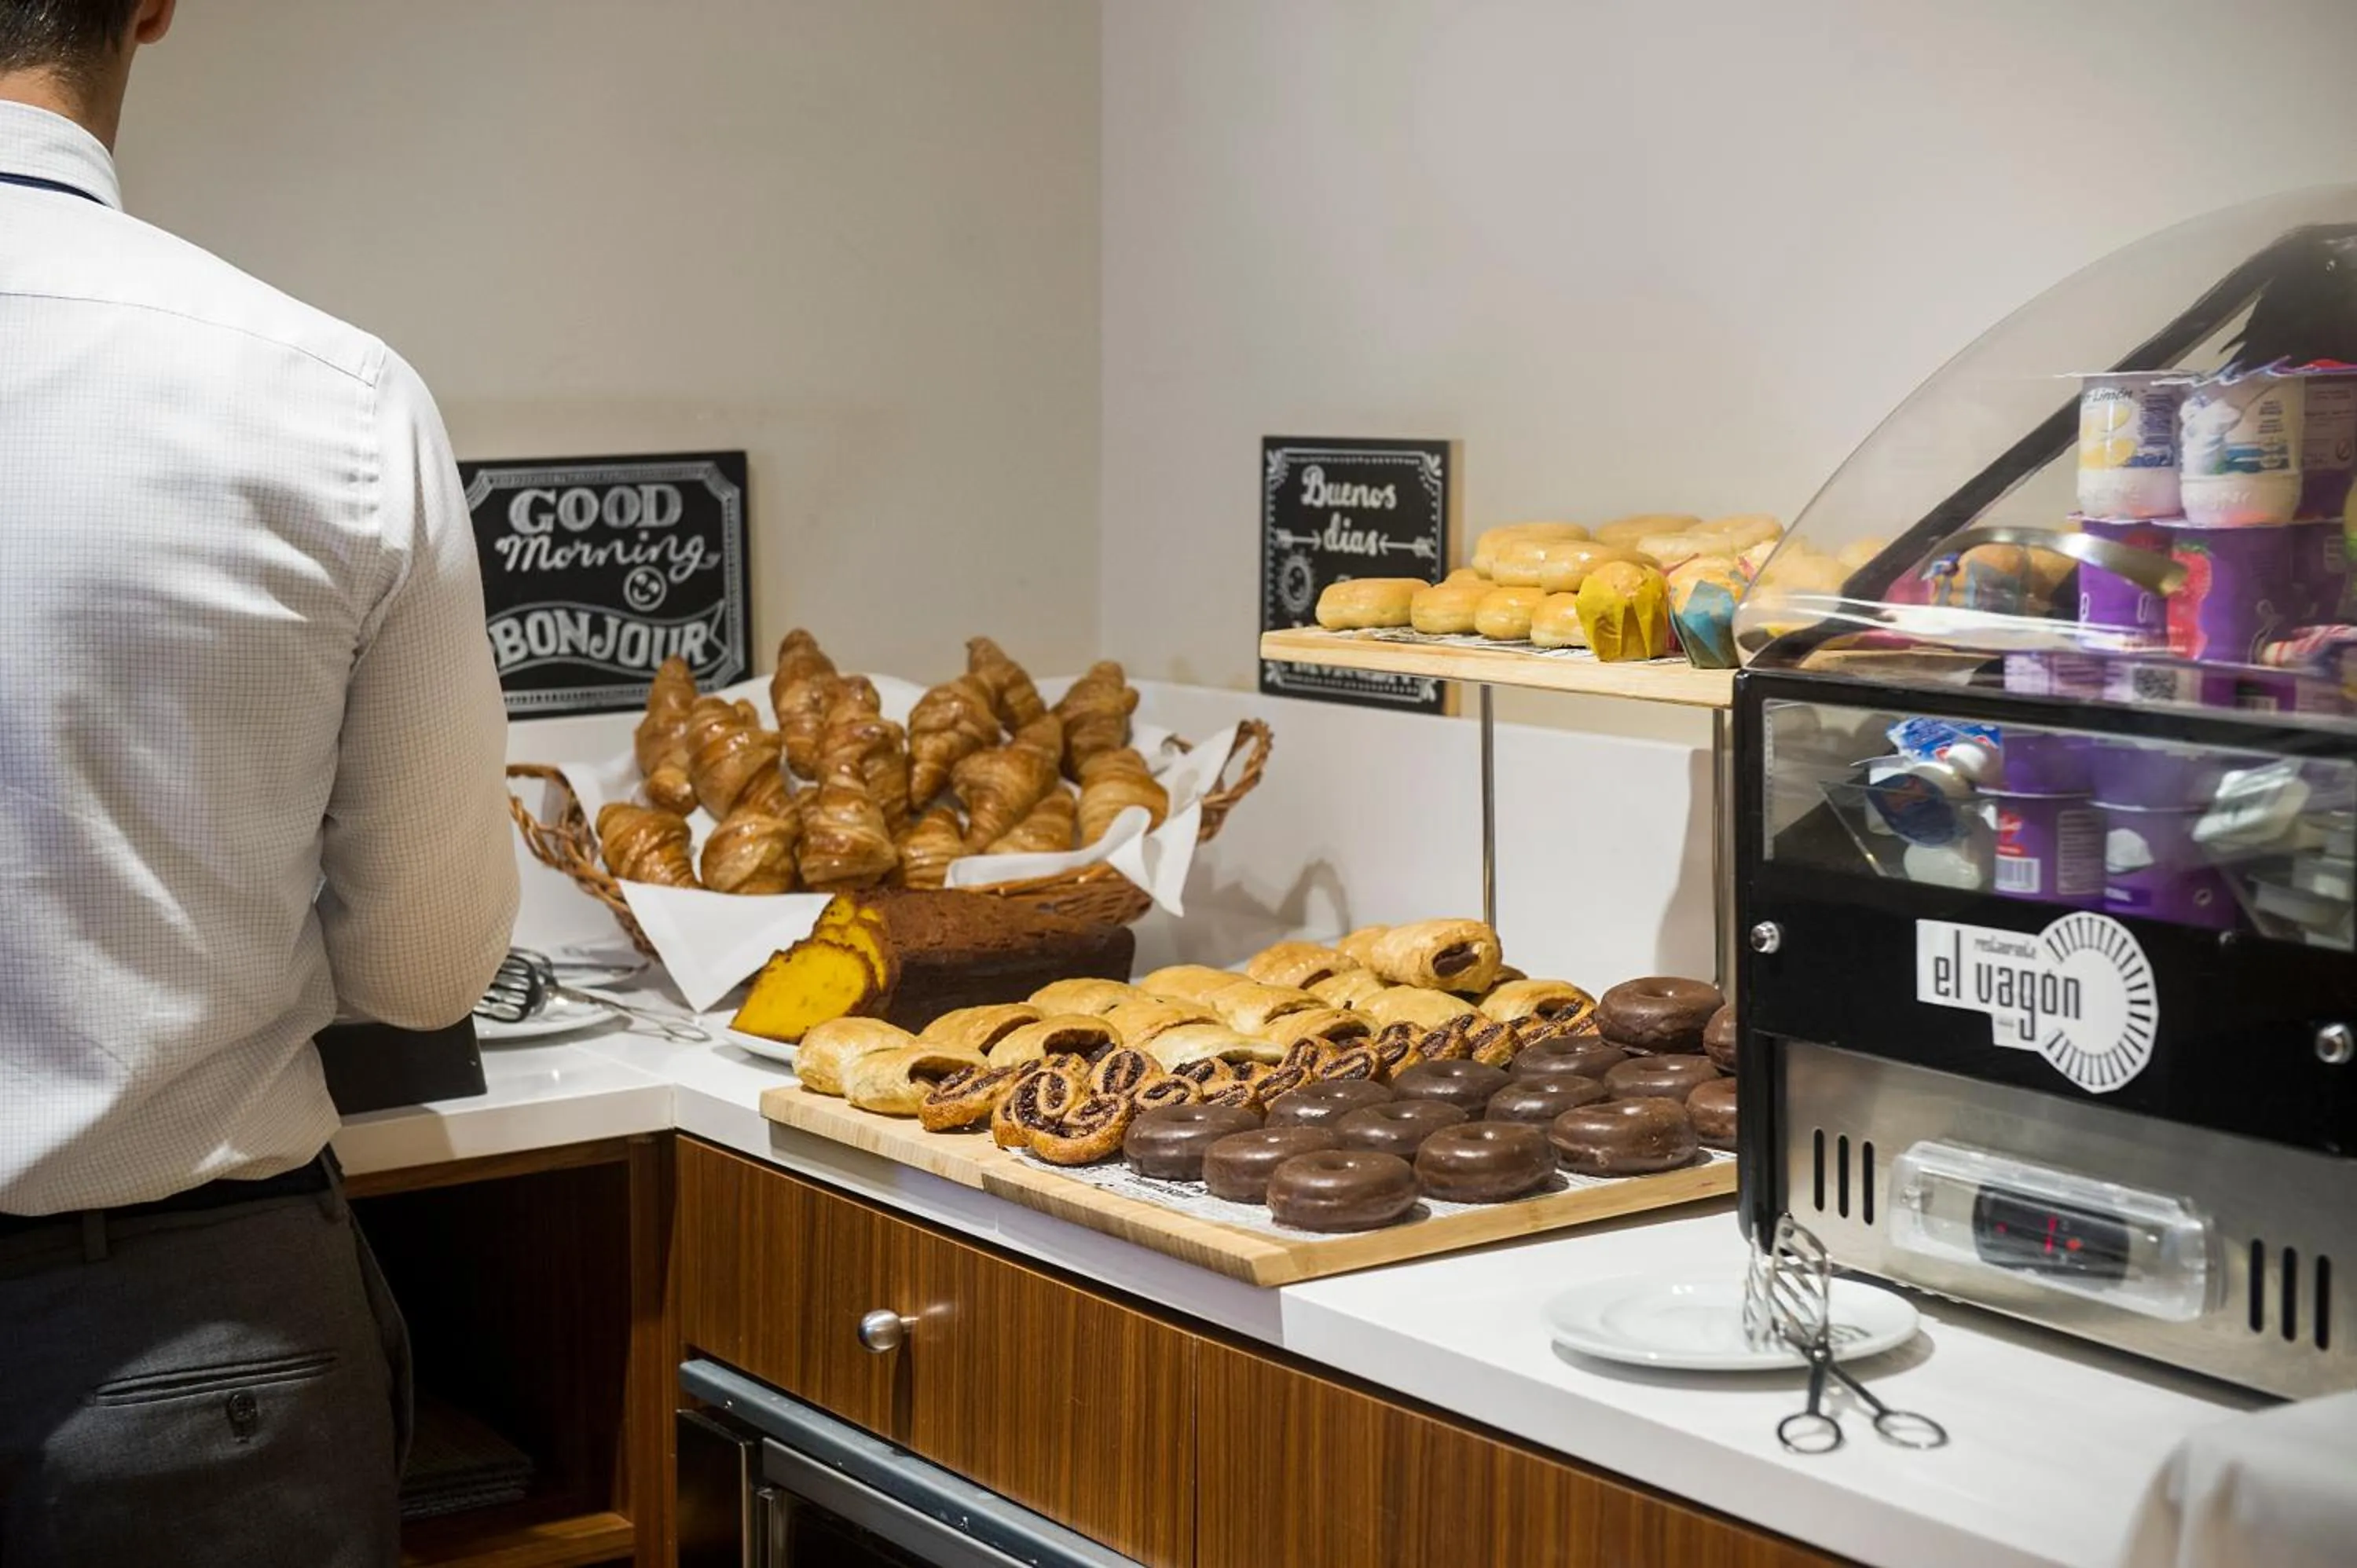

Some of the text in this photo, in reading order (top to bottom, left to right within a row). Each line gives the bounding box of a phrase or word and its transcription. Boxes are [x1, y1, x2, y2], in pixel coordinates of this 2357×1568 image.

[508, 483, 683, 535] GOOD
[1300, 464, 1398, 509] Buenos
[494, 530, 720, 584] Morning
[488, 609, 709, 669] BONJOUR
[1934, 929, 1961, 1000] el
